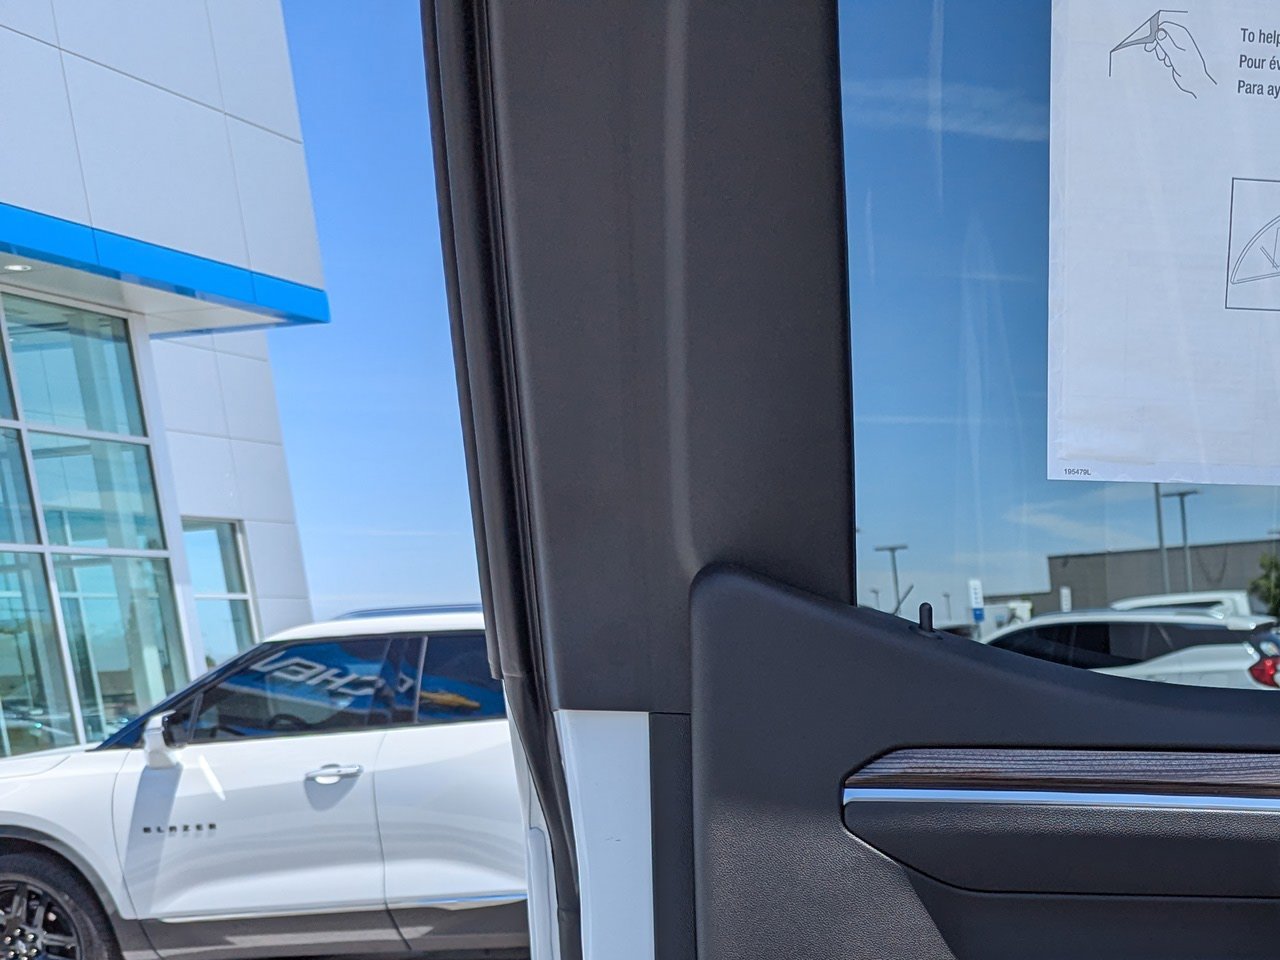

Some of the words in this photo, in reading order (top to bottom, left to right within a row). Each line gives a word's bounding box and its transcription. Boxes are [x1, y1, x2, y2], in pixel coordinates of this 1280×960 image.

[1240, 28, 1255, 43] To
[1239, 54, 1266, 70] Pour
[1238, 80, 1264, 95] Para
